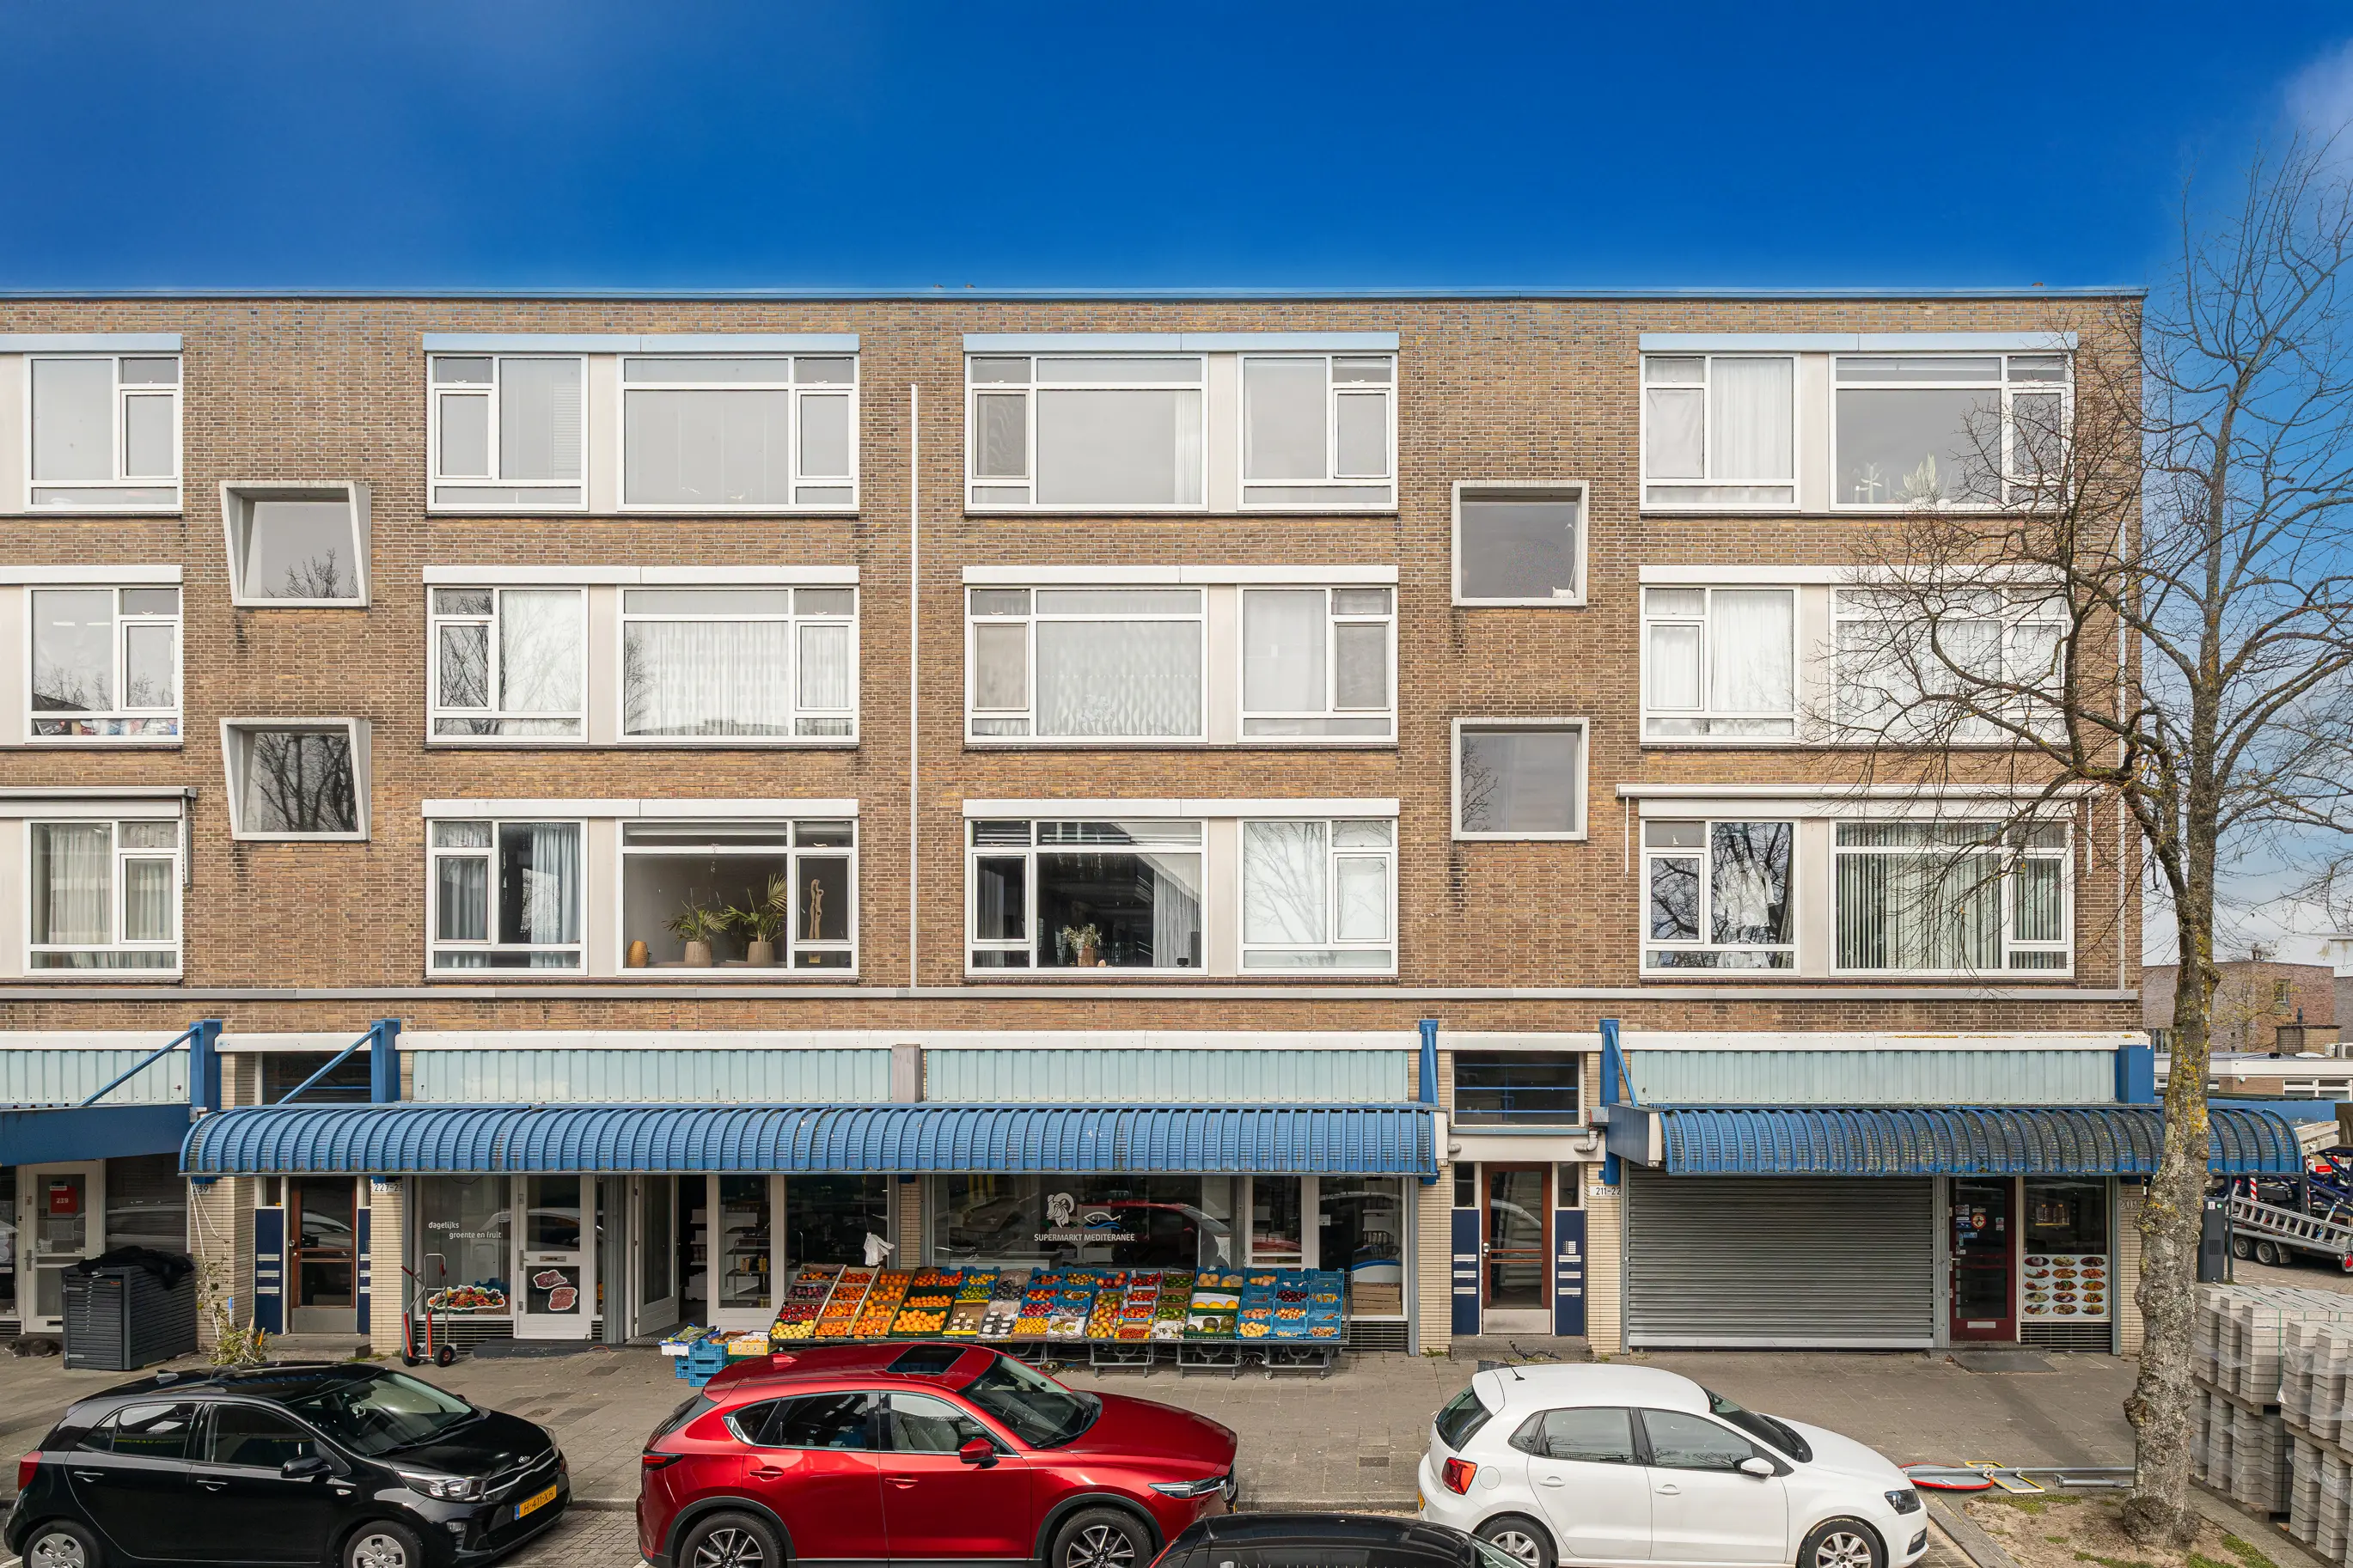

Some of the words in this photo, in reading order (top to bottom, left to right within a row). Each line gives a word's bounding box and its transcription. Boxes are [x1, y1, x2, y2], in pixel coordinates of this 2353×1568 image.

[428, 1221, 460, 1230] dagelijks
[449, 1231, 475, 1240] groente
[486, 1230, 502, 1239] fruit
[1034, 1233, 1083, 1242] SUPERMARKT
